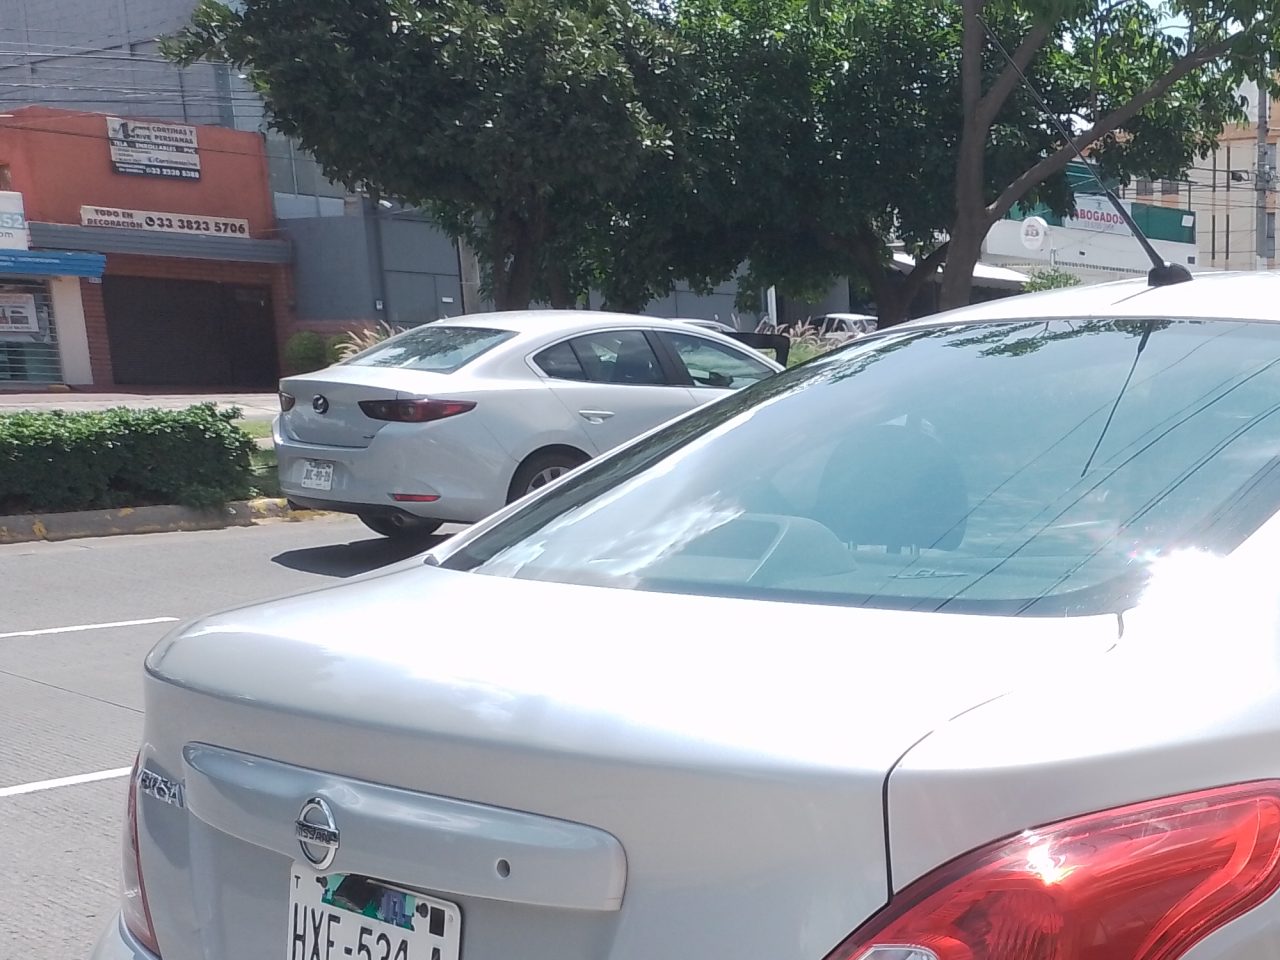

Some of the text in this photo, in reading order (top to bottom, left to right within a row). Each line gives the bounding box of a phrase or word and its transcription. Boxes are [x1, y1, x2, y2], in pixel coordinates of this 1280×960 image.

[152, 126, 187, 136] CORTINAS
[154, 134, 193, 144] PERSIANAS
[135, 142, 176, 152] ENROLLABLES
[94, 209, 133, 219] TODO EN
[1073, 208, 1125, 225] ABOGADOS
[157, 217, 246, 234] 33 3823 5706
[296, 824, 331, 844] NISSAN
[294, 875, 301, 889] T
